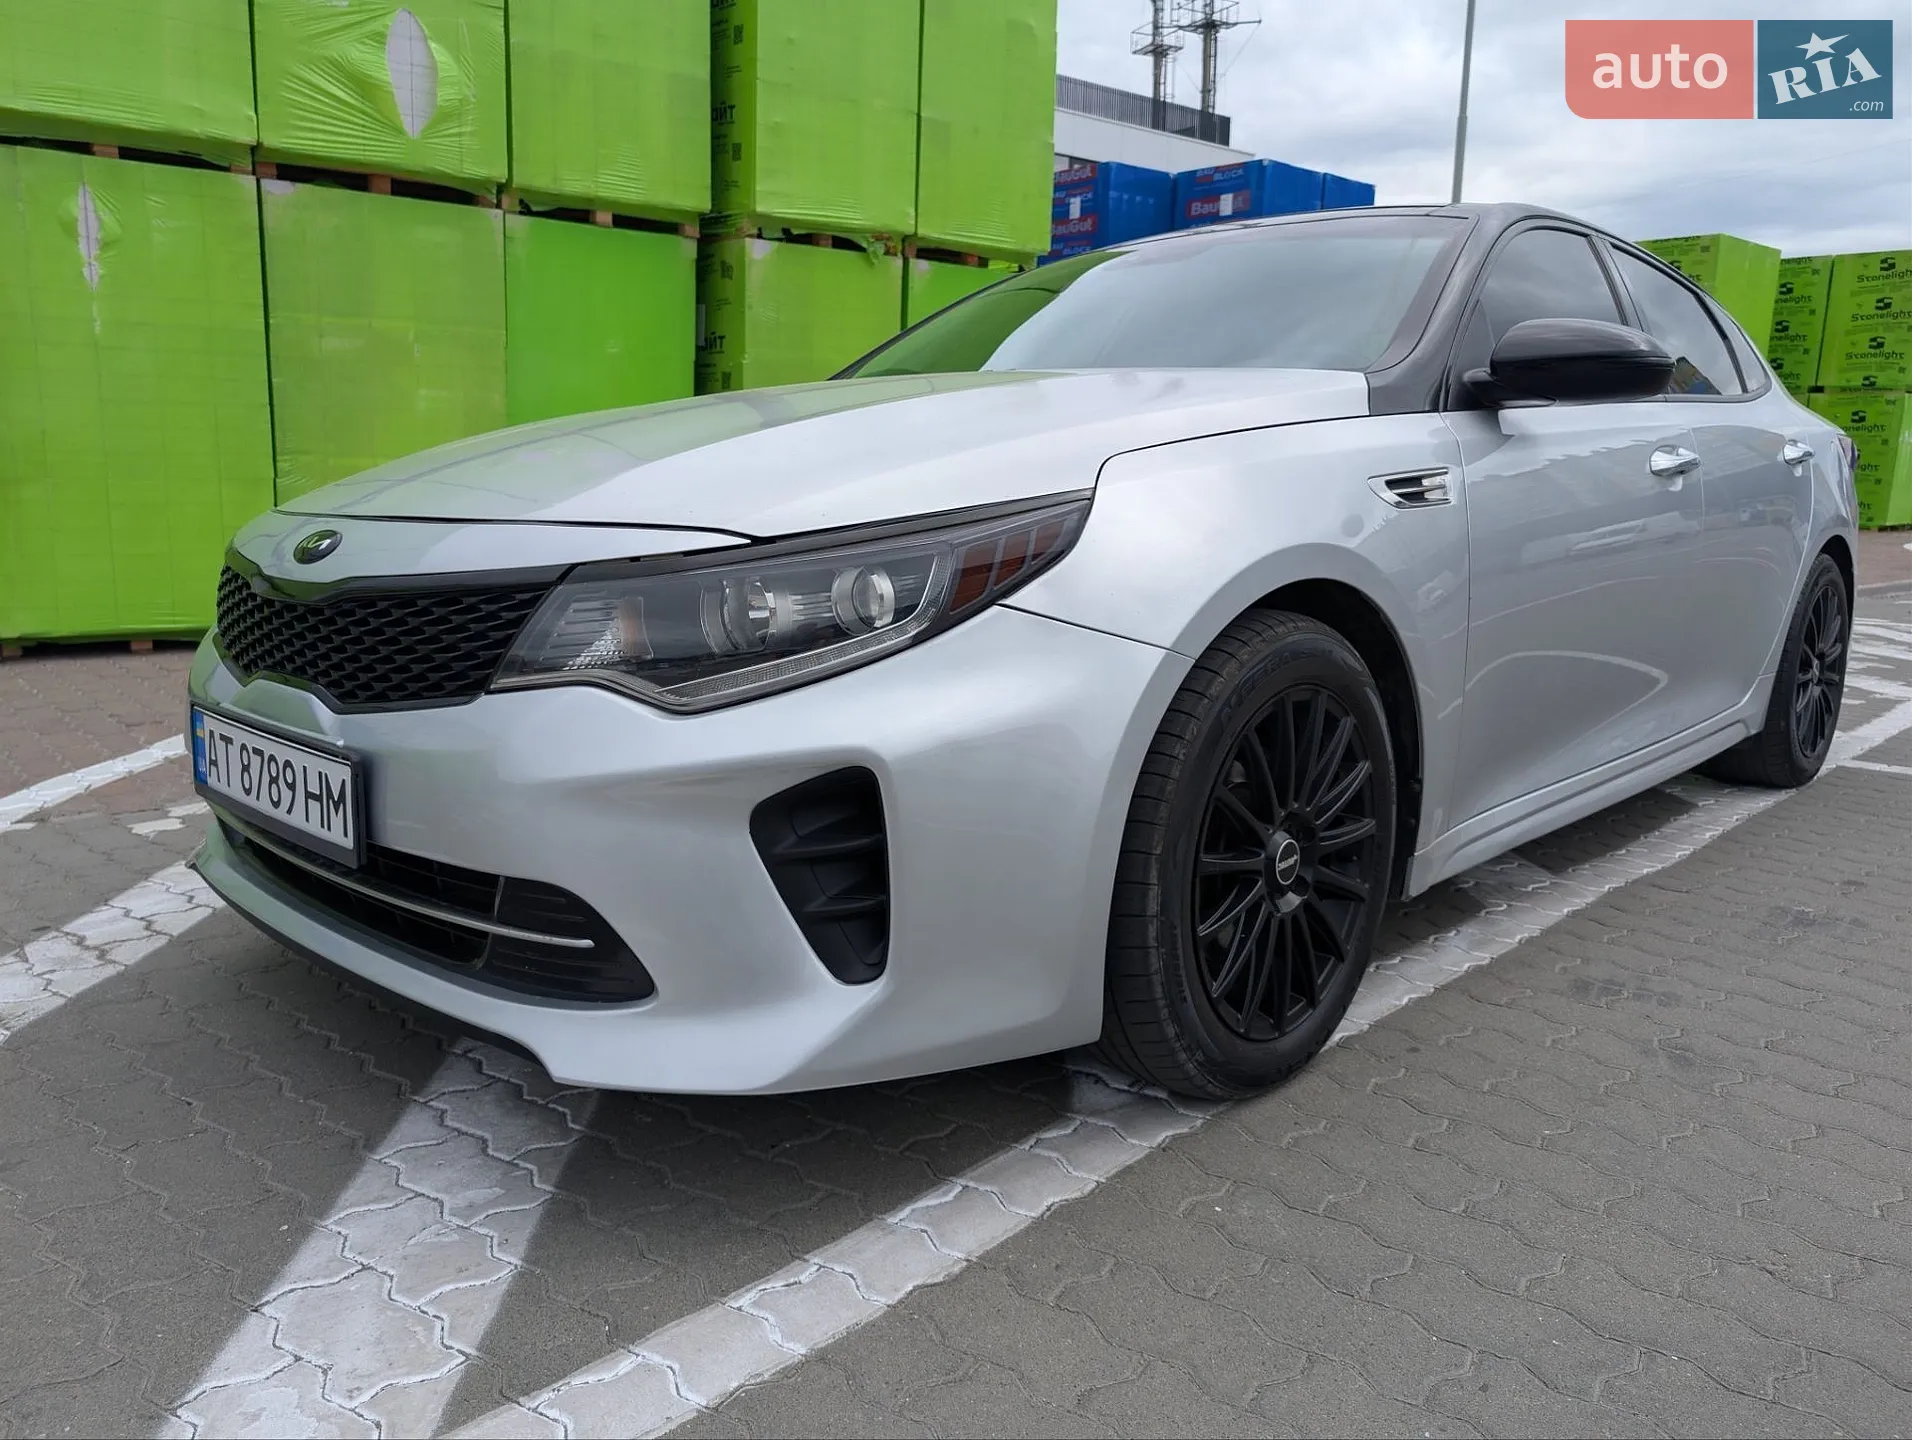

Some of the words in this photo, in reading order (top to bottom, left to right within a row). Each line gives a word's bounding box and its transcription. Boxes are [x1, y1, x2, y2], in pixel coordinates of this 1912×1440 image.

[1845, 350, 1905, 361] Stonelight
[208, 728, 234, 788] AT
[239, 742, 297, 816] 8789
[302, 764, 349, 839] HM
